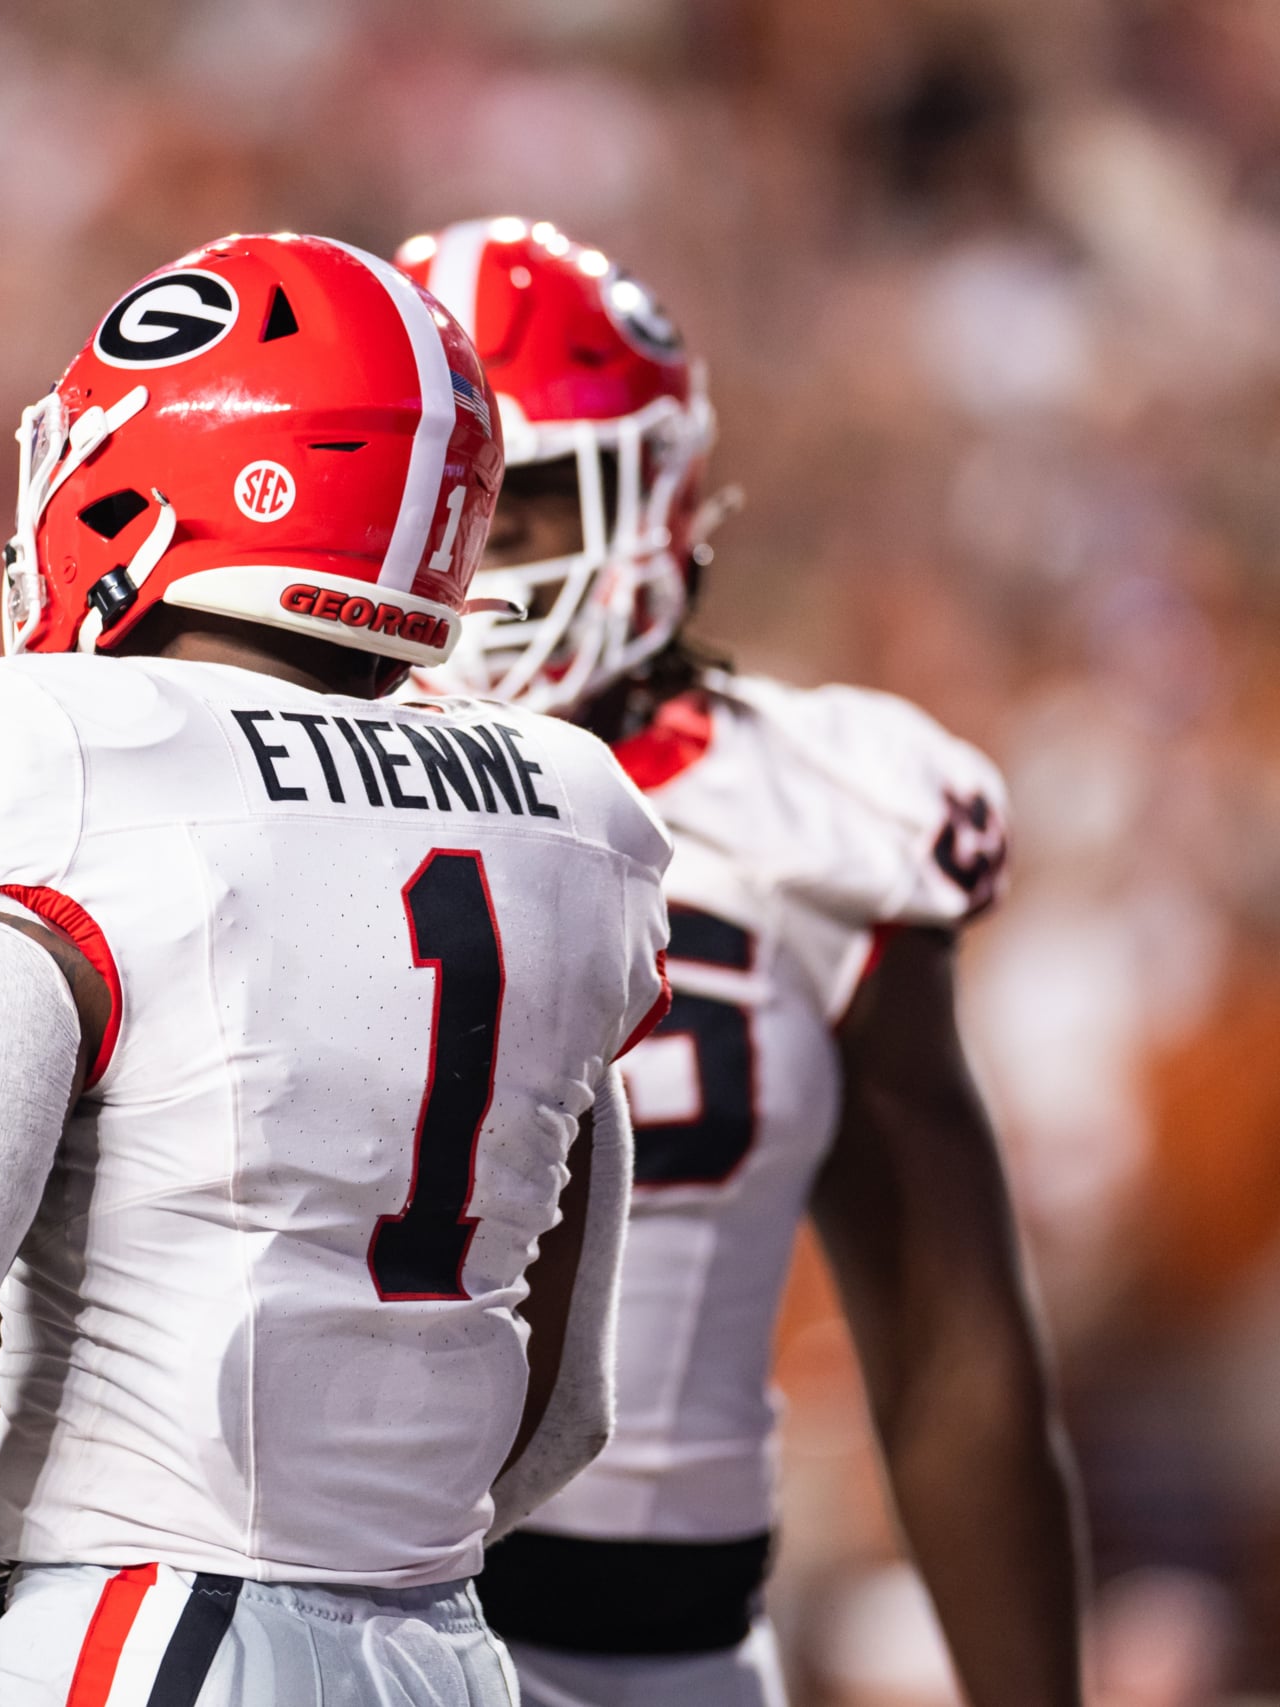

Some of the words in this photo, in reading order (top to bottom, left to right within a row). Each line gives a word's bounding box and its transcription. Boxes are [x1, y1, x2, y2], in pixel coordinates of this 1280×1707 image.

[98, 273, 233, 362] G
[241, 466, 289, 516] SEC
[427, 484, 467, 573] 1
[230, 709, 560, 819] ETIENNE
[367, 846, 507, 1303] 1
